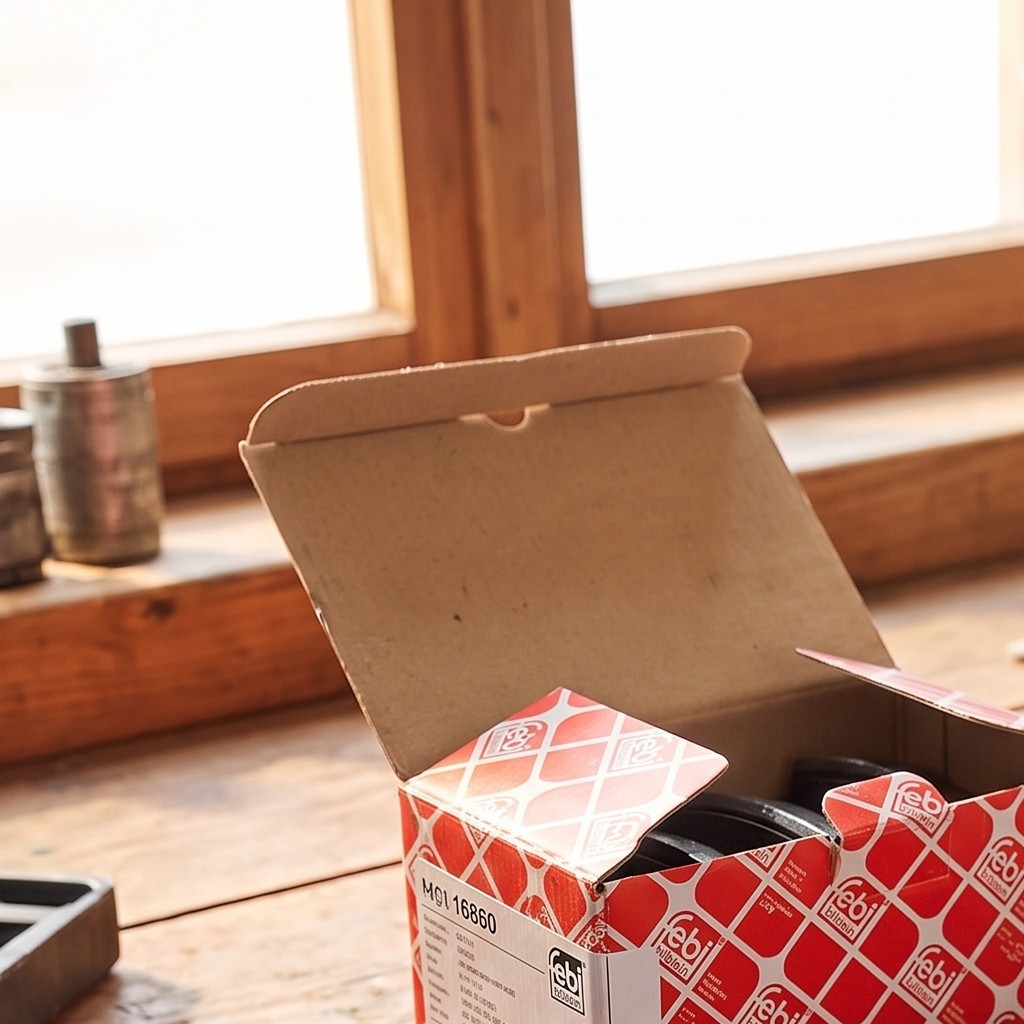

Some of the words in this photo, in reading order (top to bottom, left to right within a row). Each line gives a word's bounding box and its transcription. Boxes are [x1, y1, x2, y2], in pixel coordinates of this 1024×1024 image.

[453, 895, 497, 935] 16860
[831, 880, 879, 927] febi
[656, 914, 714, 967] febi
[550, 950, 582, 997] febi
[911, 948, 957, 997] febi
